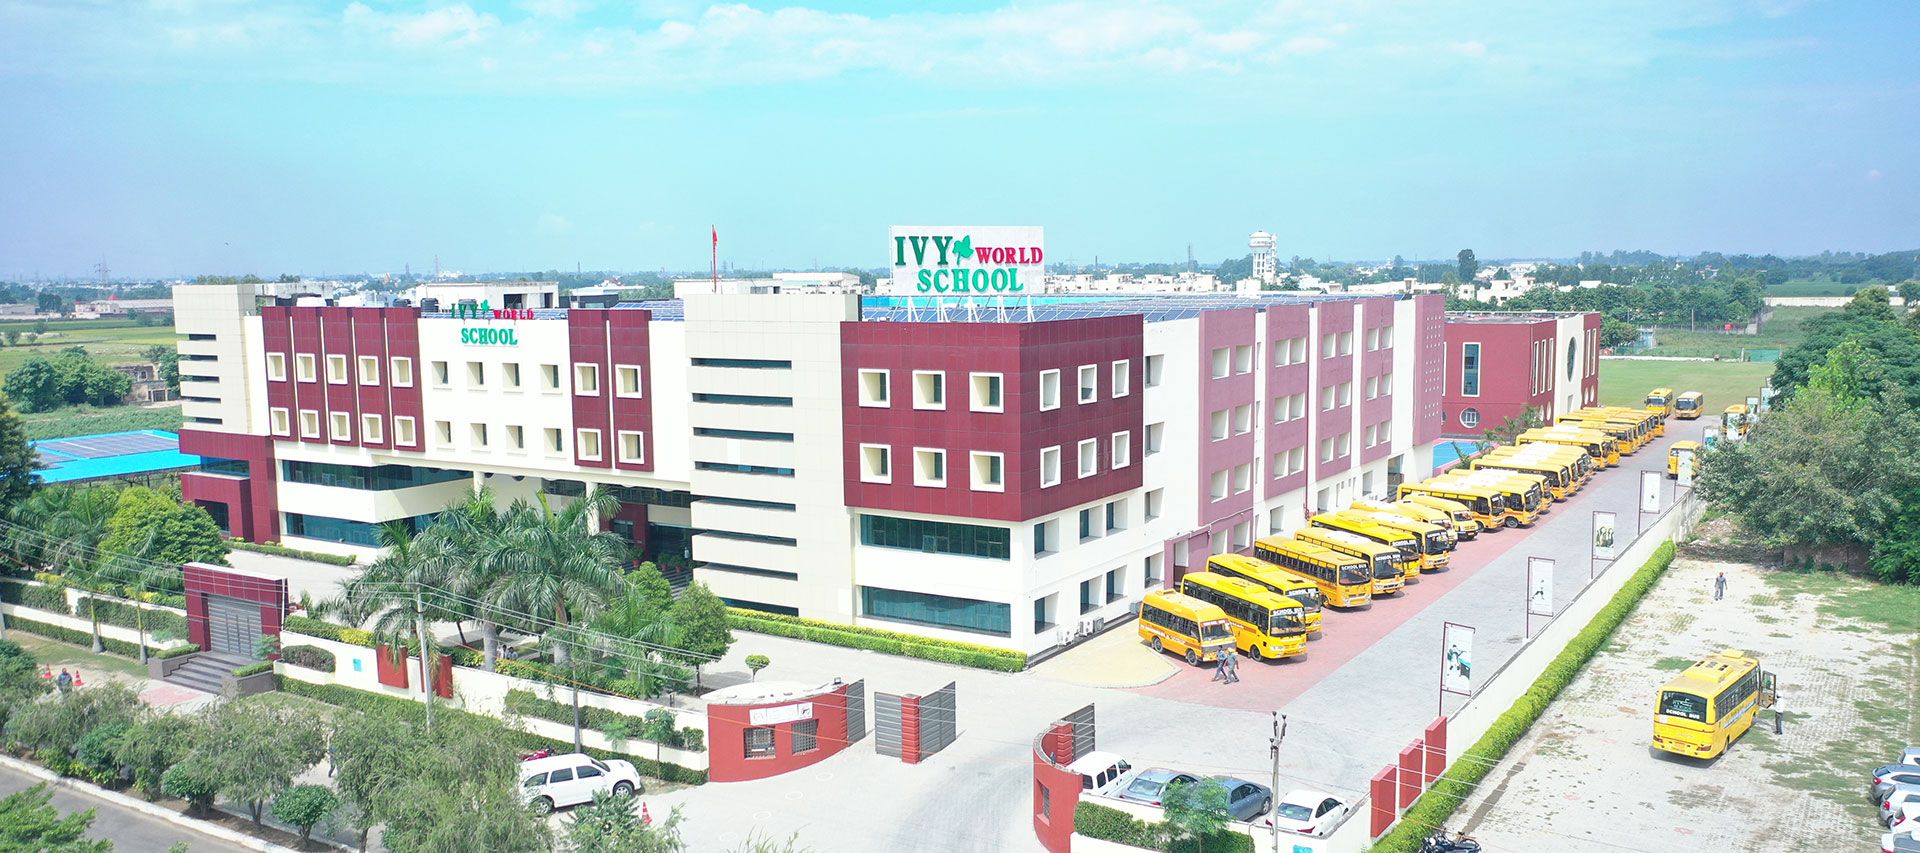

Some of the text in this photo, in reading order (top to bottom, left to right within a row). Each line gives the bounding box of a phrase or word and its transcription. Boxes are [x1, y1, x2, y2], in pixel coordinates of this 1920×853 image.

[895, 236, 1043, 266] IVY WORLD
[917, 268, 1024, 292] SCHOOL
[451, 303, 534, 320] IVY WORLD
[461, 328, 518, 345] SCHOOL
[1666, 708, 1688, 717] SCHOOL
